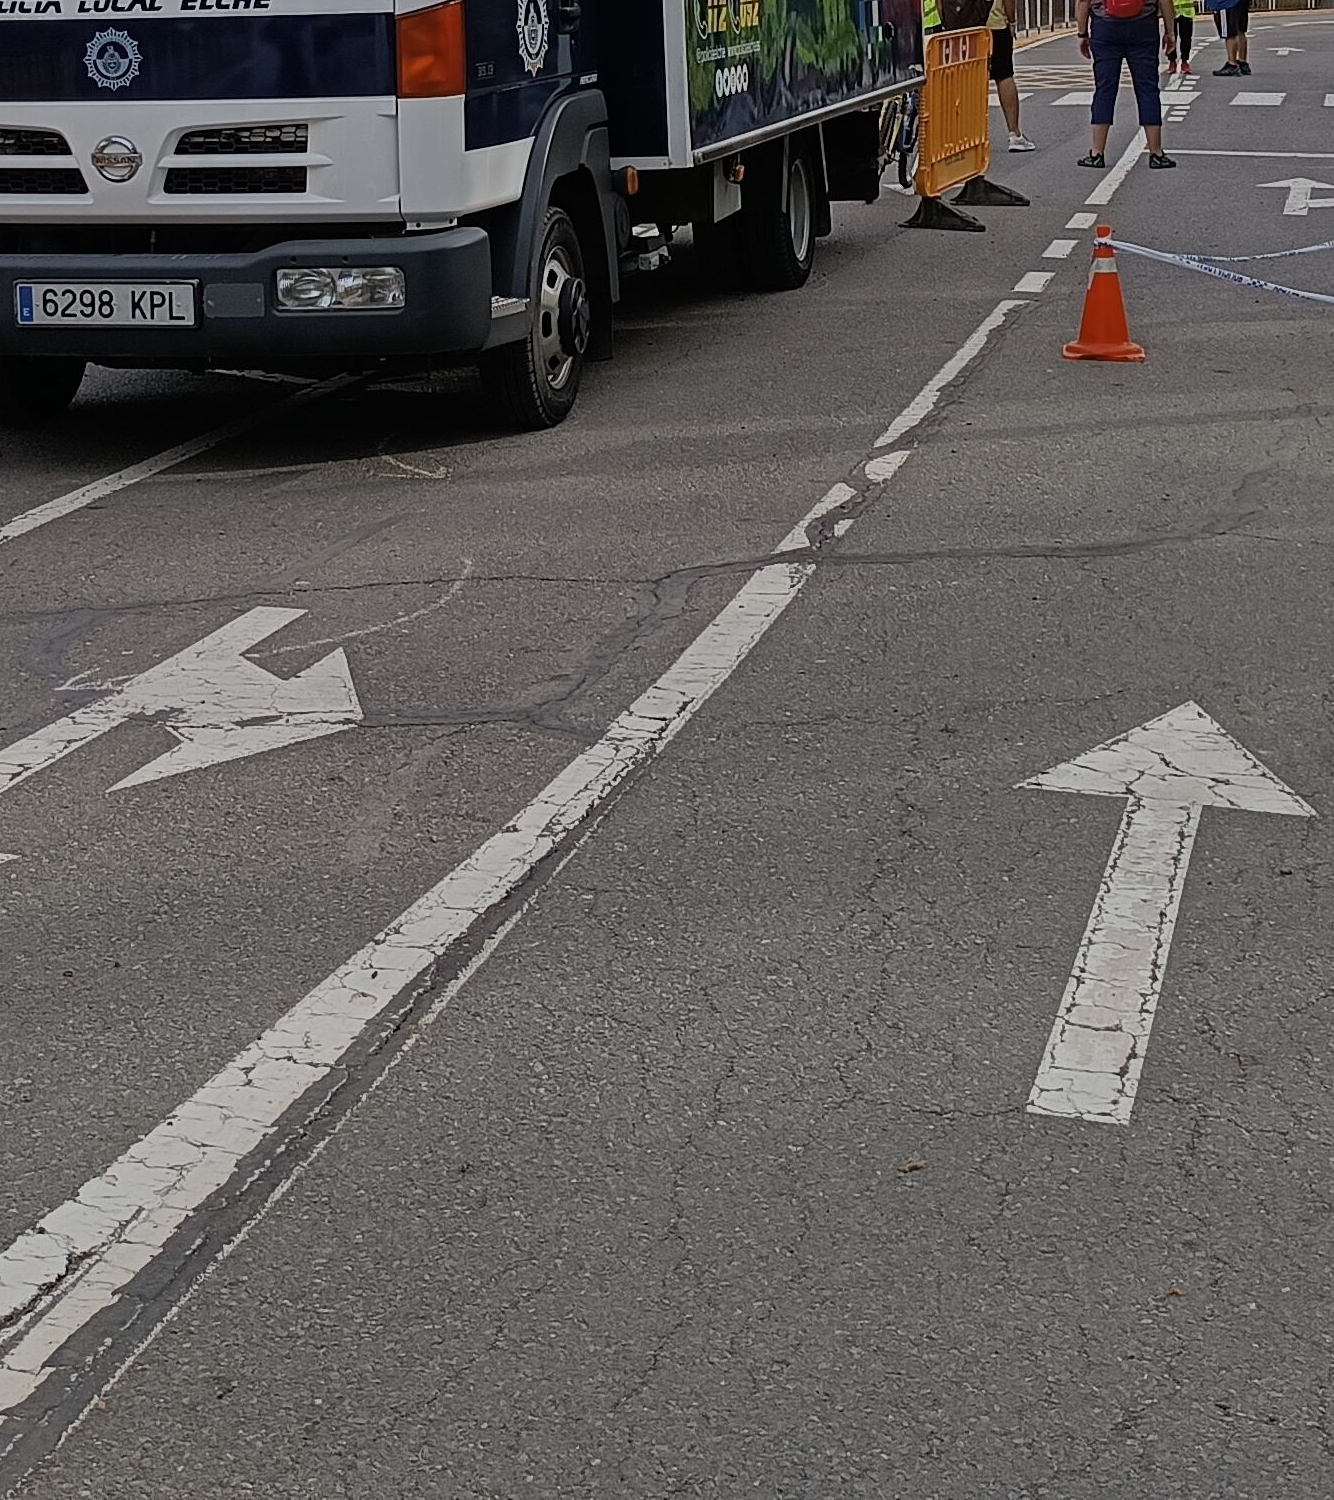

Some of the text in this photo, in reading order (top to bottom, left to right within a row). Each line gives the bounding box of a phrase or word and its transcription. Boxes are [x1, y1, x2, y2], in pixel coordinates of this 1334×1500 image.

[95, 155, 136, 165] NISSAN
[23, 288, 186, 320] E 6298 KPL
